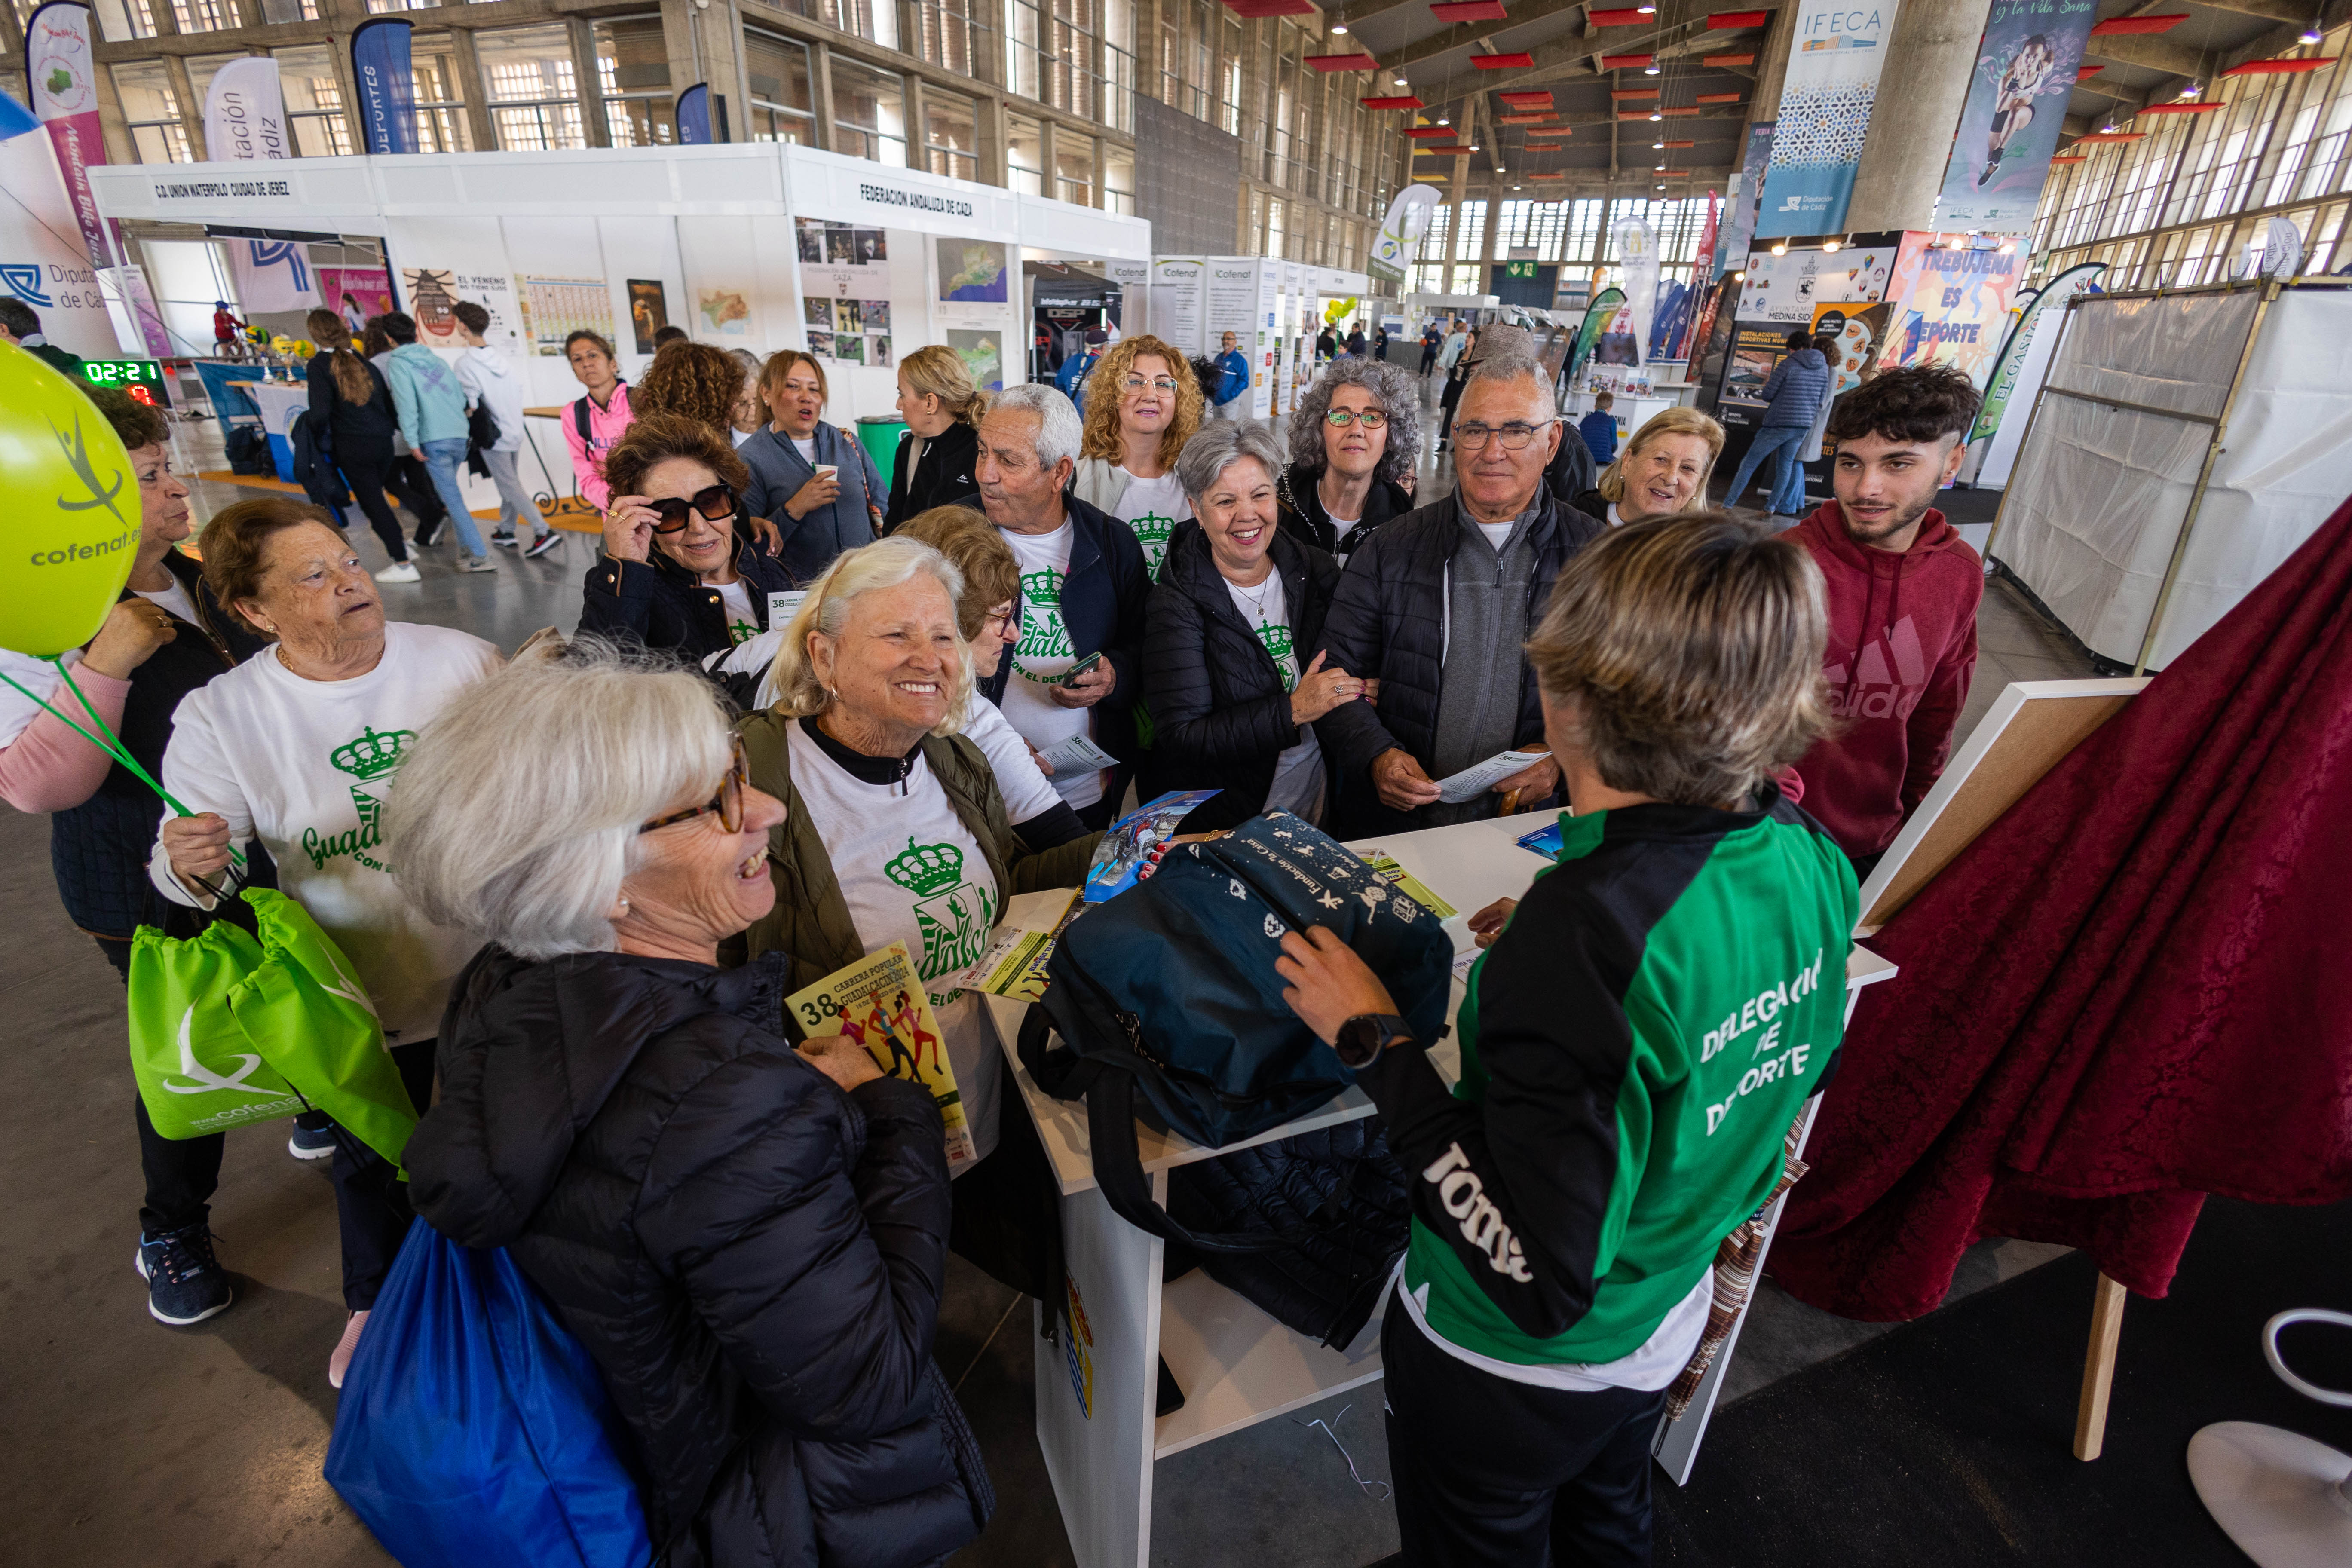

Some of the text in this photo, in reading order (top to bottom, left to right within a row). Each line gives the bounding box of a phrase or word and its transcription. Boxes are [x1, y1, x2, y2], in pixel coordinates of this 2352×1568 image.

[1994, 6, 2006, 24] y
[2012, 0, 2025, 15] la
[2059, 0, 2092, 14] Sana
[1804, 10, 1881, 35] IFECA
[155, 181, 290, 198] C.D. UNION WATERPOLO CIUDAD DE JEREZ
[860, 184, 973, 217] FEDERACION ANDALUZA DE CAZA
[1803, 196, 1834, 204] Diputación
[78, 194, 94, 228] Bike
[1922, 249, 2015, 275] TREBUJENA
[471, 276, 506, 285] VENENO
[832, 273, 853, 282] CAZA
[1166, 269, 1197, 278] Cofenat
[1218, 270, 1251, 279] Cofenat
[61, 291, 81, 308] de
[1941, 287, 1962, 309] ES
[1768, 312, 1795, 321] MEDINA
[1919, 322, 1981, 343] EPORTE
[86, 363, 157, 381] 02:21
[1994, 380, 2012, 402] EL
[31, 525, 142, 567] cofenat.es
[772, 600, 785, 608] 38
[1025, 671, 1039, 682] EL
[1071, 736, 1082, 744] 38
[354, 852, 383, 871] CON
[1278, 859, 1322, 894] Fundación
[1029, 952, 1048, 972] DEPORTE
[800, 954, 904, 1026] 38 CARRERA POPULAR
[929, 988, 966, 1007] EL DE
